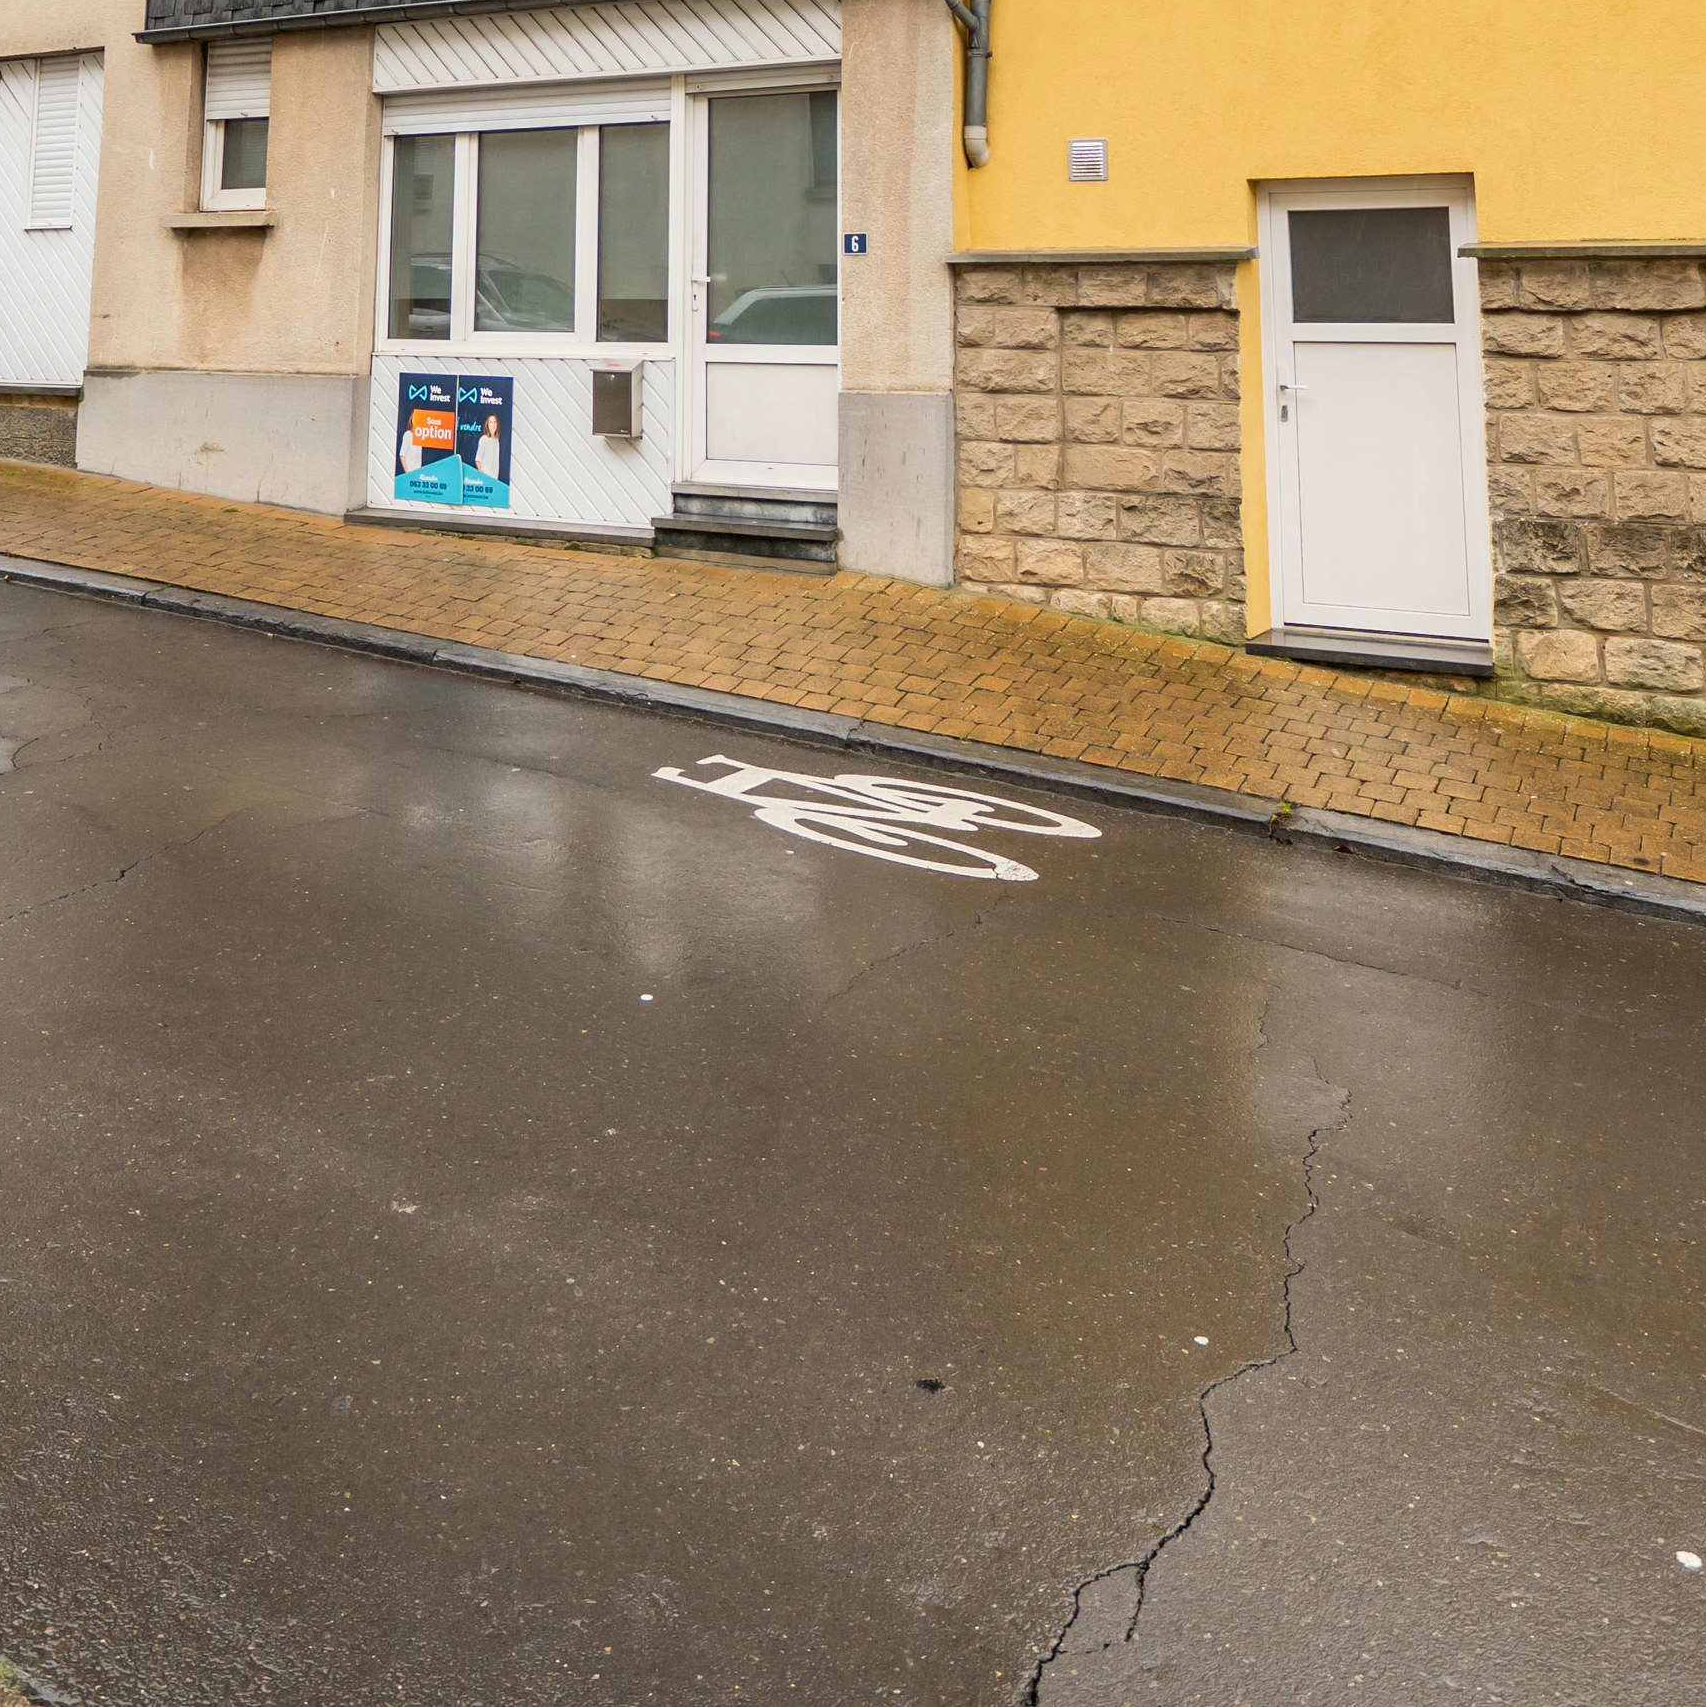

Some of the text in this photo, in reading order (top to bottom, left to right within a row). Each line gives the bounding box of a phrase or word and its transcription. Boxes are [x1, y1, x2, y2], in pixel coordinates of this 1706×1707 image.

[851, 235, 859, 253] 6
[430, 385, 442, 394] We
[480, 388, 493, 396] We
[430, 393, 451, 402] Invest
[480, 396, 503, 405] Invest
[426, 417, 442, 425] Sous
[460, 421, 482, 432] vendre
[414, 426, 452, 441] option
[409, 480, 421, 488] 063
[422, 481, 430, 489] 33
[475, 485, 484, 493] 00
